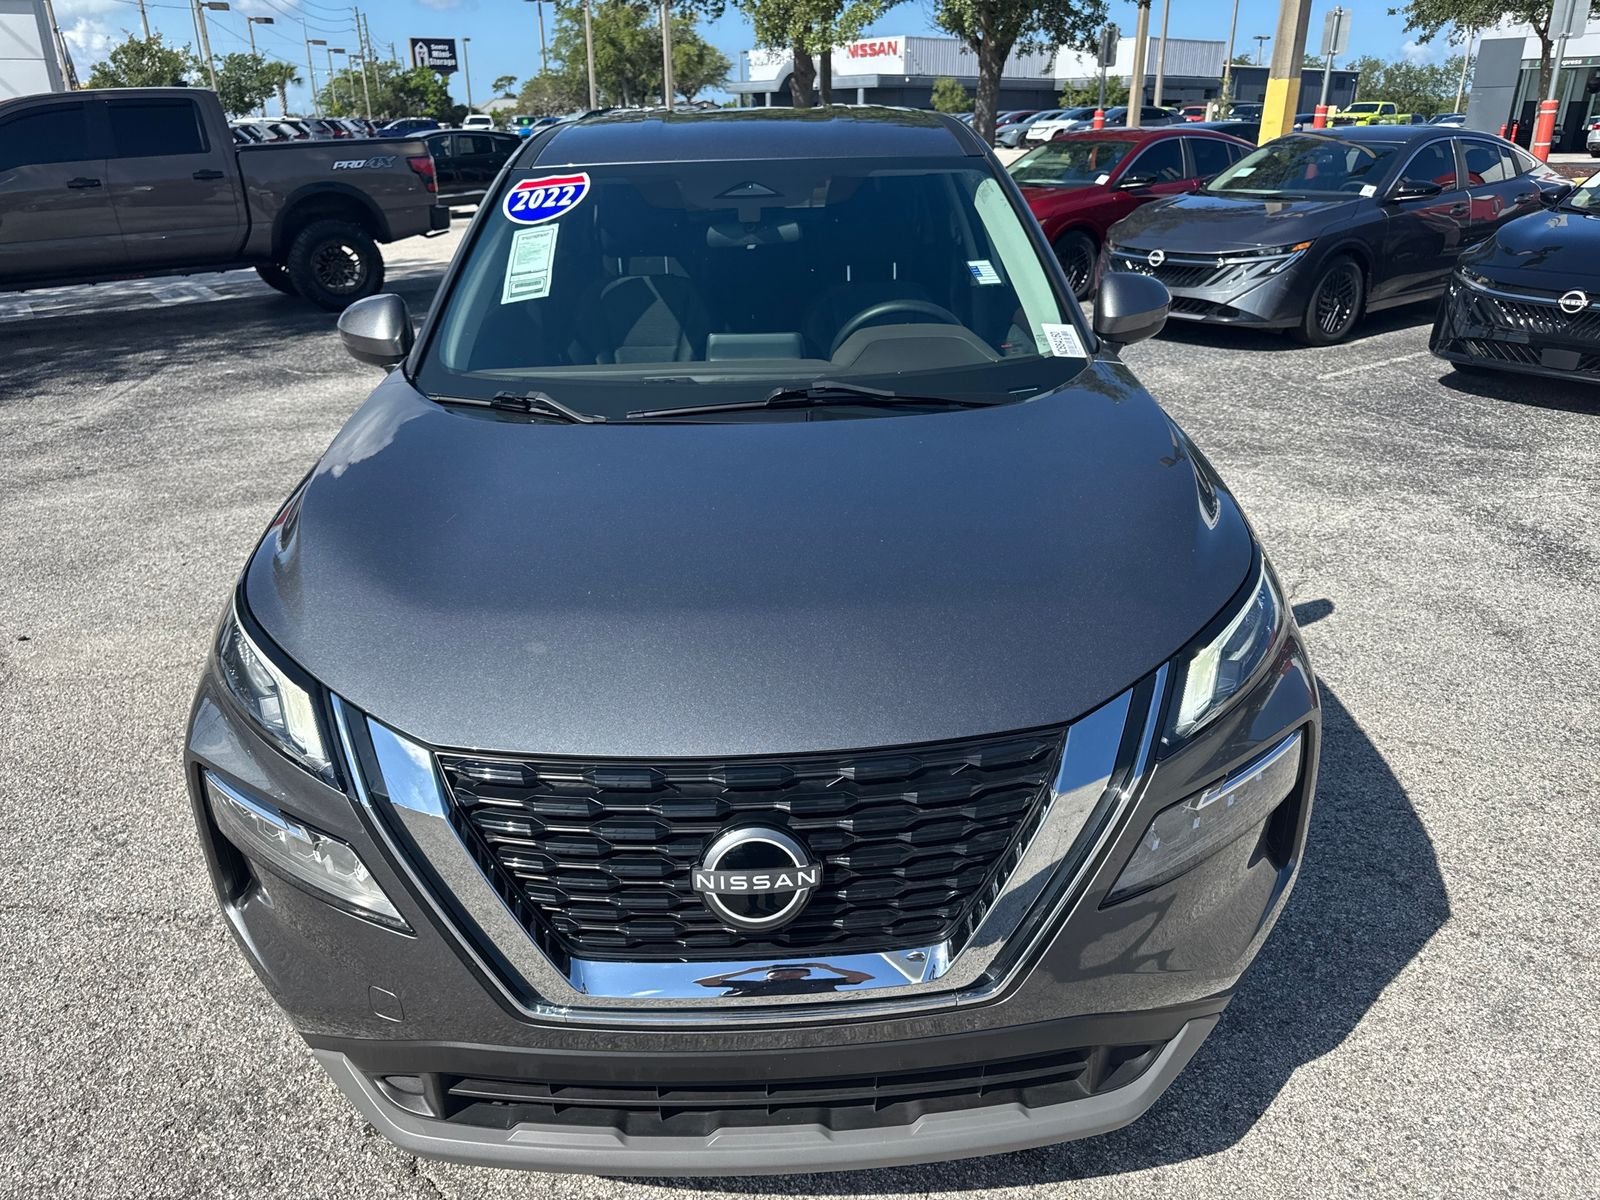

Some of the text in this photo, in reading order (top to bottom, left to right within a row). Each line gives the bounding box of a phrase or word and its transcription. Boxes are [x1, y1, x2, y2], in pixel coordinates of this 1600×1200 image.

[848, 41, 897, 58] NISSAN
[429, 58, 456, 66] Storage
[511, 185, 576, 212] 2022
[695, 868, 816, 890] NISSAN
